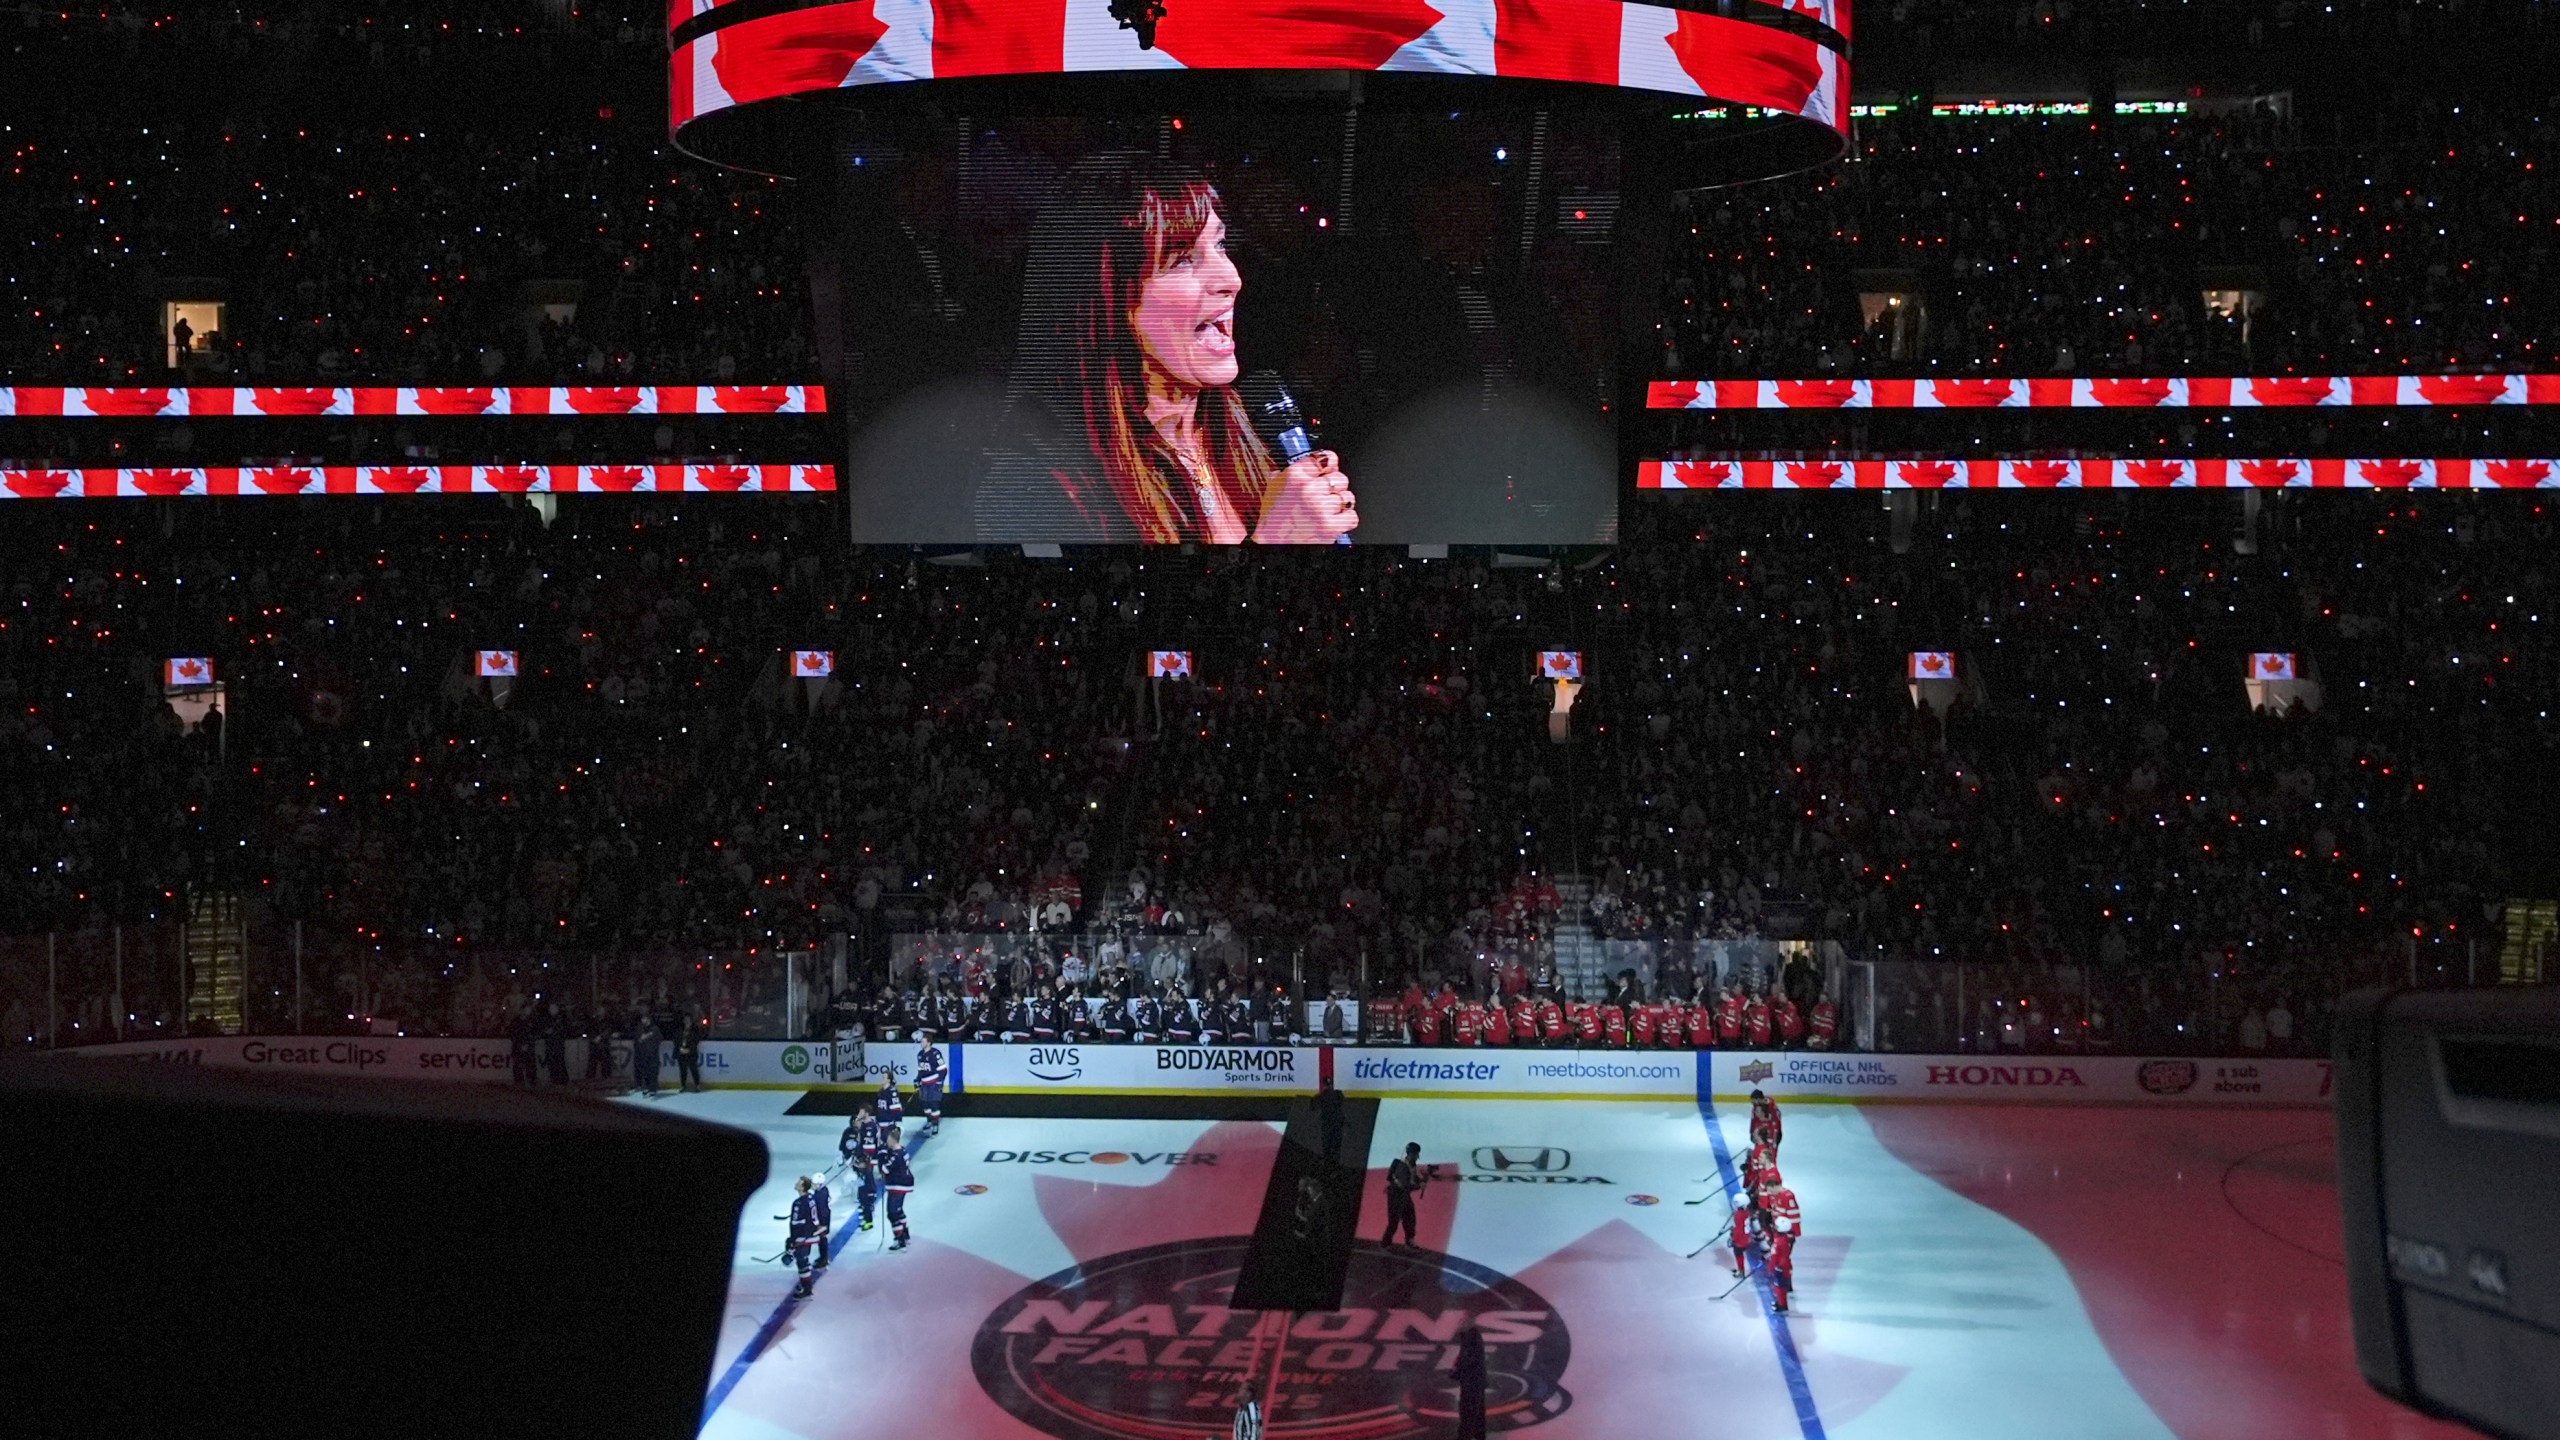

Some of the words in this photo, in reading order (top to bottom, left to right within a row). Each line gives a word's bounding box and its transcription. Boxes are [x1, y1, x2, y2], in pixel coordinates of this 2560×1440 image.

[242, 1041, 318, 1064] Great
[325, 1042, 386, 1070] Clips
[1029, 1047, 1080, 1066] aws
[1156, 1048, 1294, 1072] BODYARMOR
[1353, 1057, 1501, 1081] ticketmaster
[1527, 1061, 1681, 1079] meetboston.com
[1789, 1060, 1853, 1073] OFFICIAL
[1857, 1062, 1886, 1073] NHL
[1925, 1065, 2086, 1086] HONDA
[1224, 1072, 1261, 1084] Sports
[1264, 1071, 1295, 1083] Drink
[1778, 1073, 1842, 1085] TRADING
[1846, 1074, 1897, 1086] CARDS
[983, 1150, 1219, 1167] DISCOVER
[998, 1298, 1550, 1343] NATIONS
